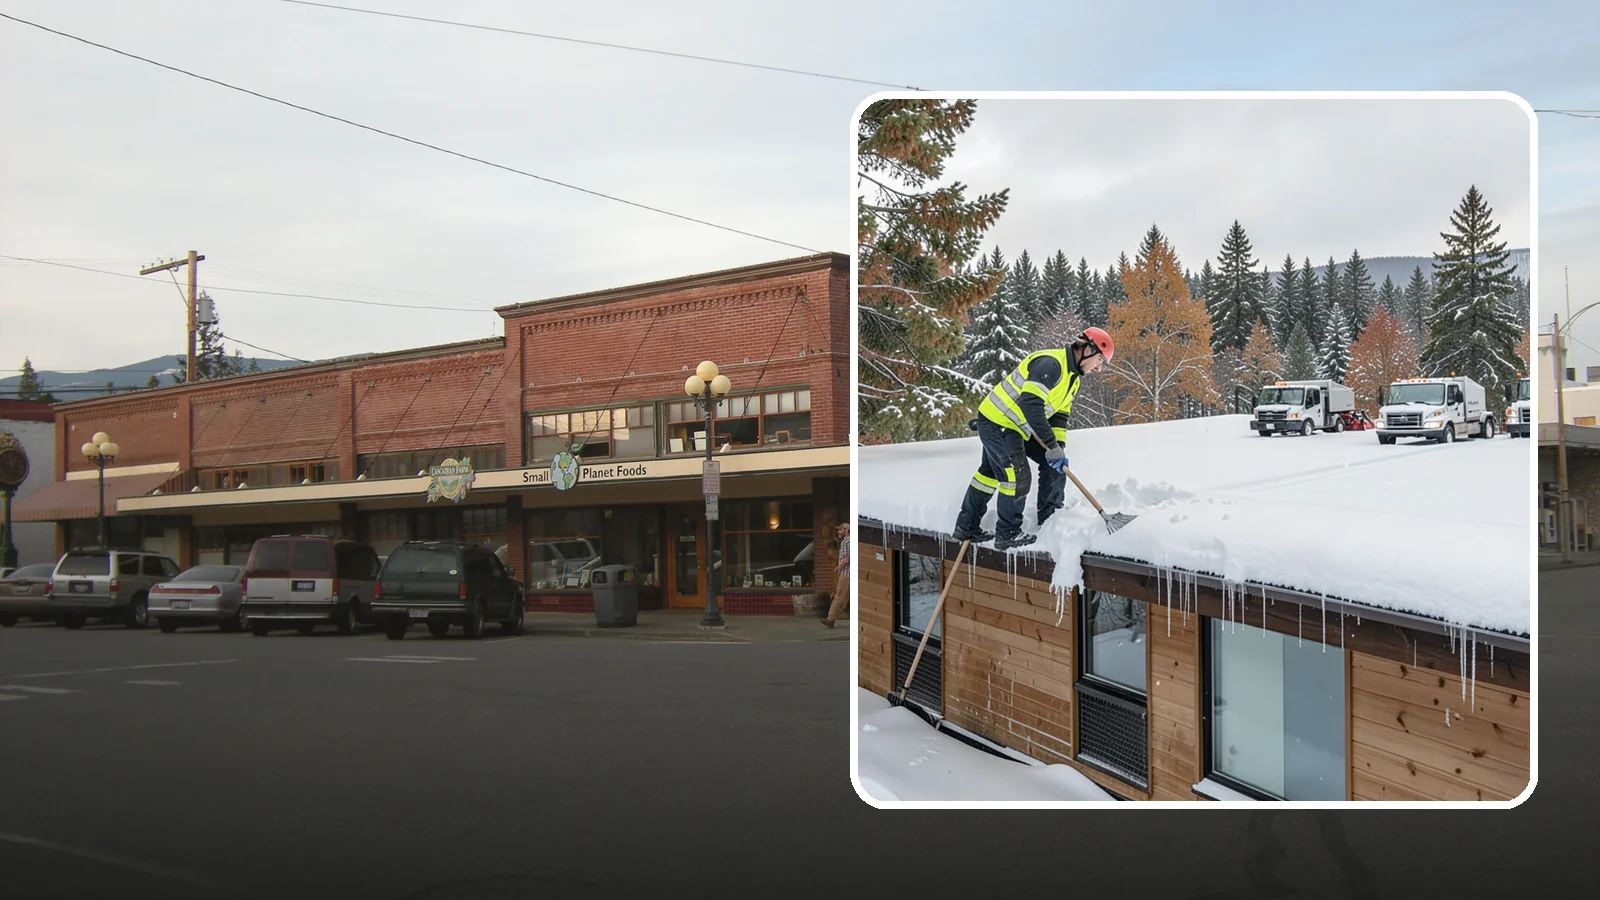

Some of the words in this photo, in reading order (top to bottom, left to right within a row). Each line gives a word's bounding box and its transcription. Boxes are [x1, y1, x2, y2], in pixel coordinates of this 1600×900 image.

[523, 471, 549, 483] Small
[583, 467, 614, 479] Planet
[617, 464, 647, 477] Foods
